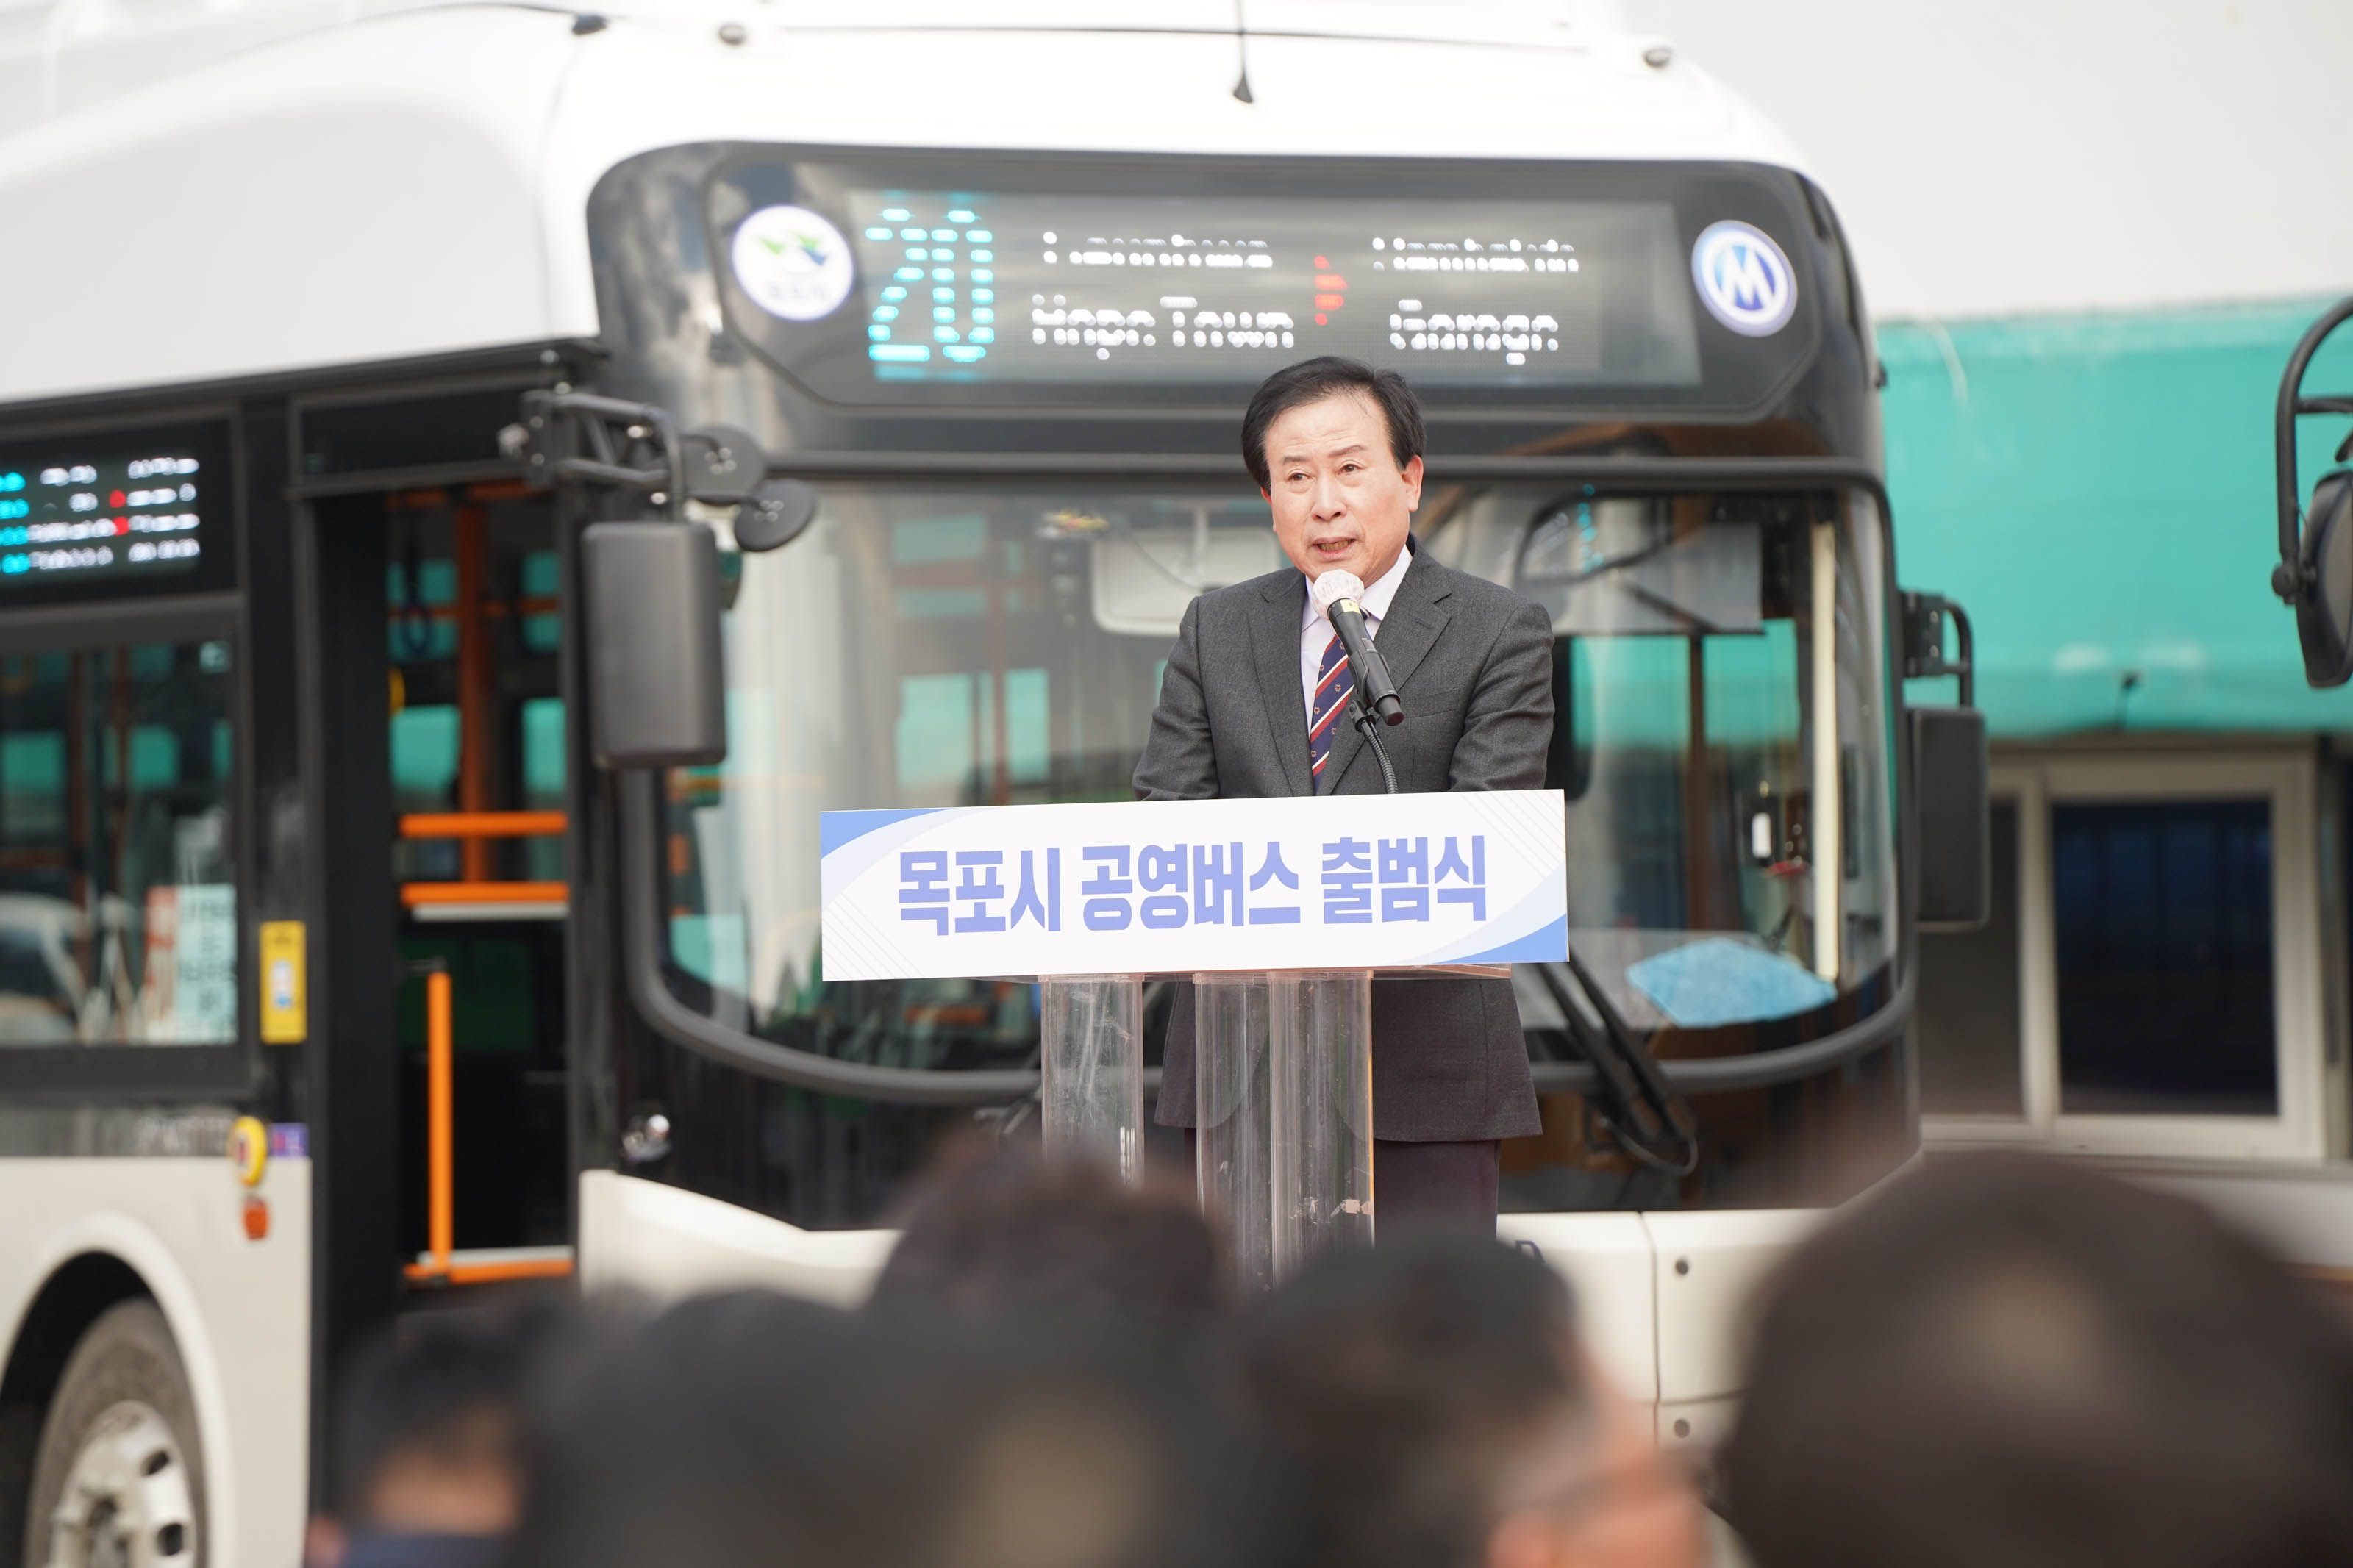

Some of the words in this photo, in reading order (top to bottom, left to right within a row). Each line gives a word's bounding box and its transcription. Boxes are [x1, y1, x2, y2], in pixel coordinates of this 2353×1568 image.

[865, 207, 994, 362] 20
[899, 847, 1061, 936] 목포시
[1081, 842, 1301, 931] 공영버스
[1321, 835, 1487, 924] 출범식
